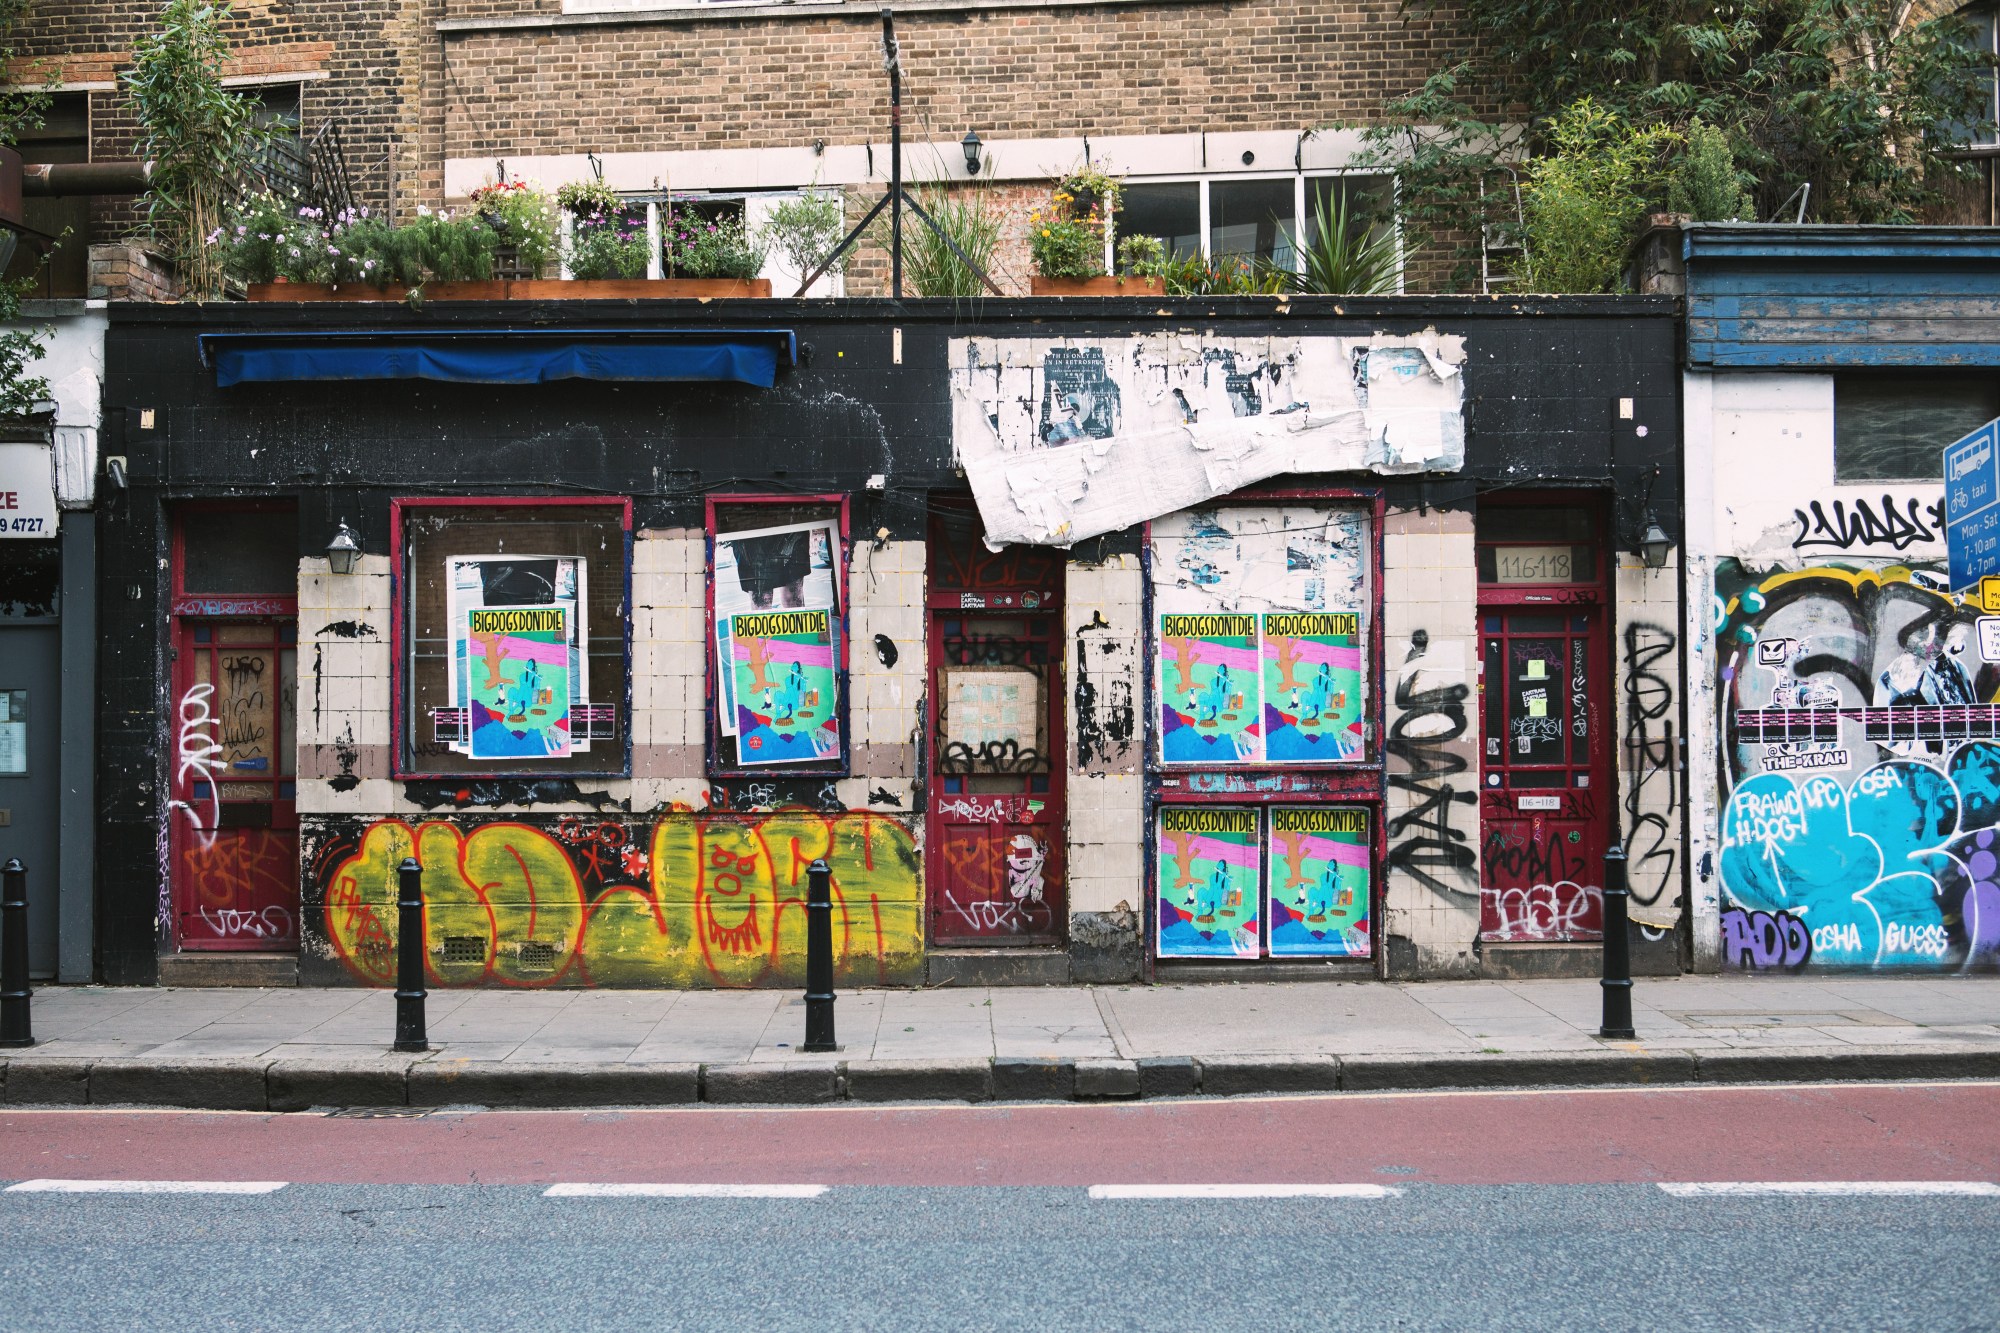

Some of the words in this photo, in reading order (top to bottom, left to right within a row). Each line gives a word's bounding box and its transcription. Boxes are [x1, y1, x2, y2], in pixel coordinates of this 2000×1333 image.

[1972, 480, 1987, 499] taxi
[11, 518, 44, 532] 4727
[1502, 554, 1570, 578] 116-118
[1812, 922, 1862, 952] OSHA
